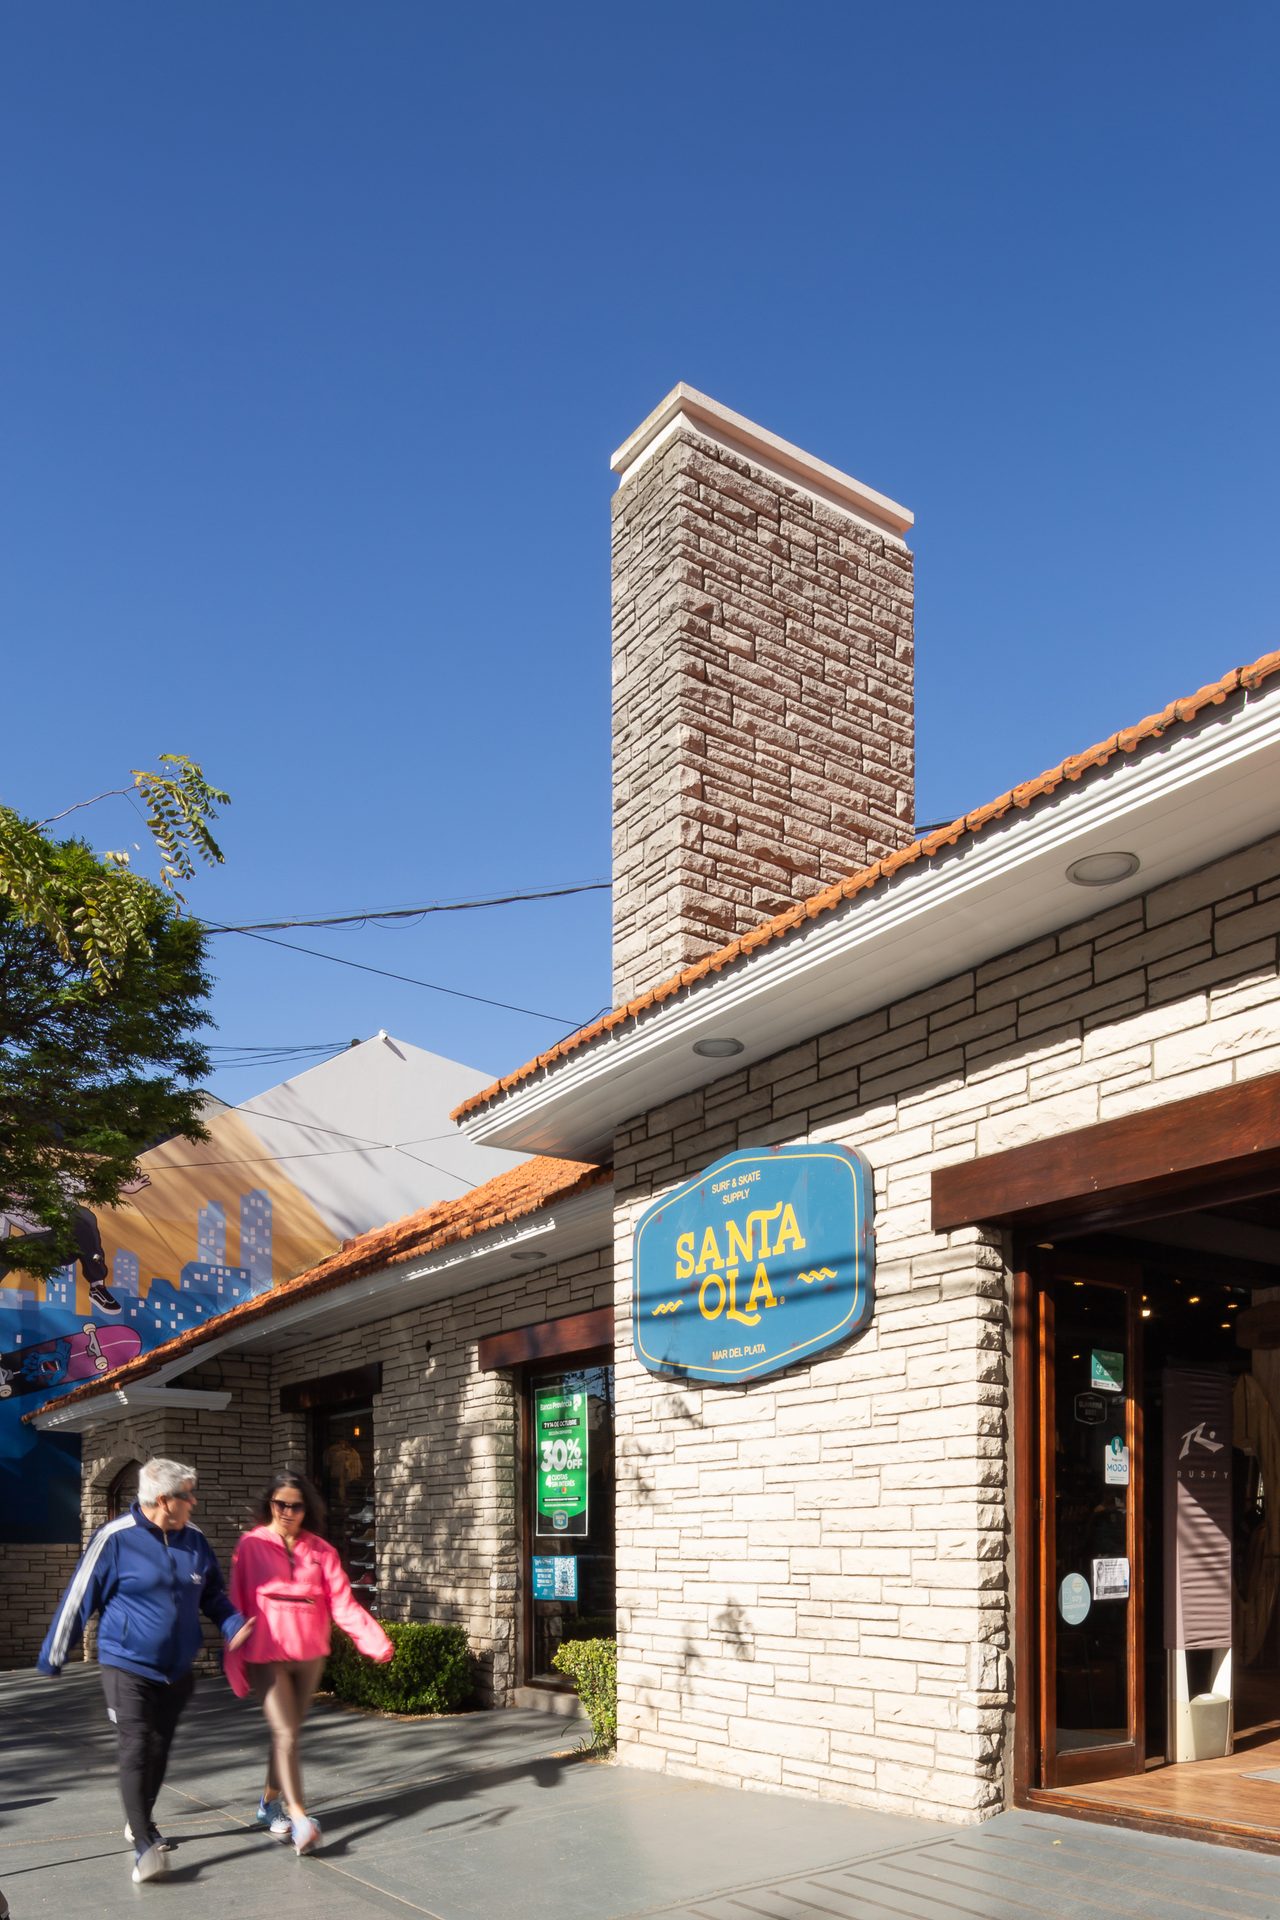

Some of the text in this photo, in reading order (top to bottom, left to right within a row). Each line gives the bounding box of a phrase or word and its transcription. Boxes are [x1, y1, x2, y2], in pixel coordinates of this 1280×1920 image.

[711, 1170, 761, 1194] SURF & SKATE
[722, 1188, 750, 1205] SUPPLY
[675, 1201, 806, 1280] SANTA
[712, 1343, 766, 1361] MAR DEL PLATA
[560, 1418, 577, 1427] OCTUBRE
[540, 1438, 581, 1472] 30%
[566, 1458, 583, 1470] OFF
[1106, 1463, 1128, 1473] MODO
[551, 1473, 568, 1481] CUOTAS
[1176, 1470, 1229, 1480] RUSTY
